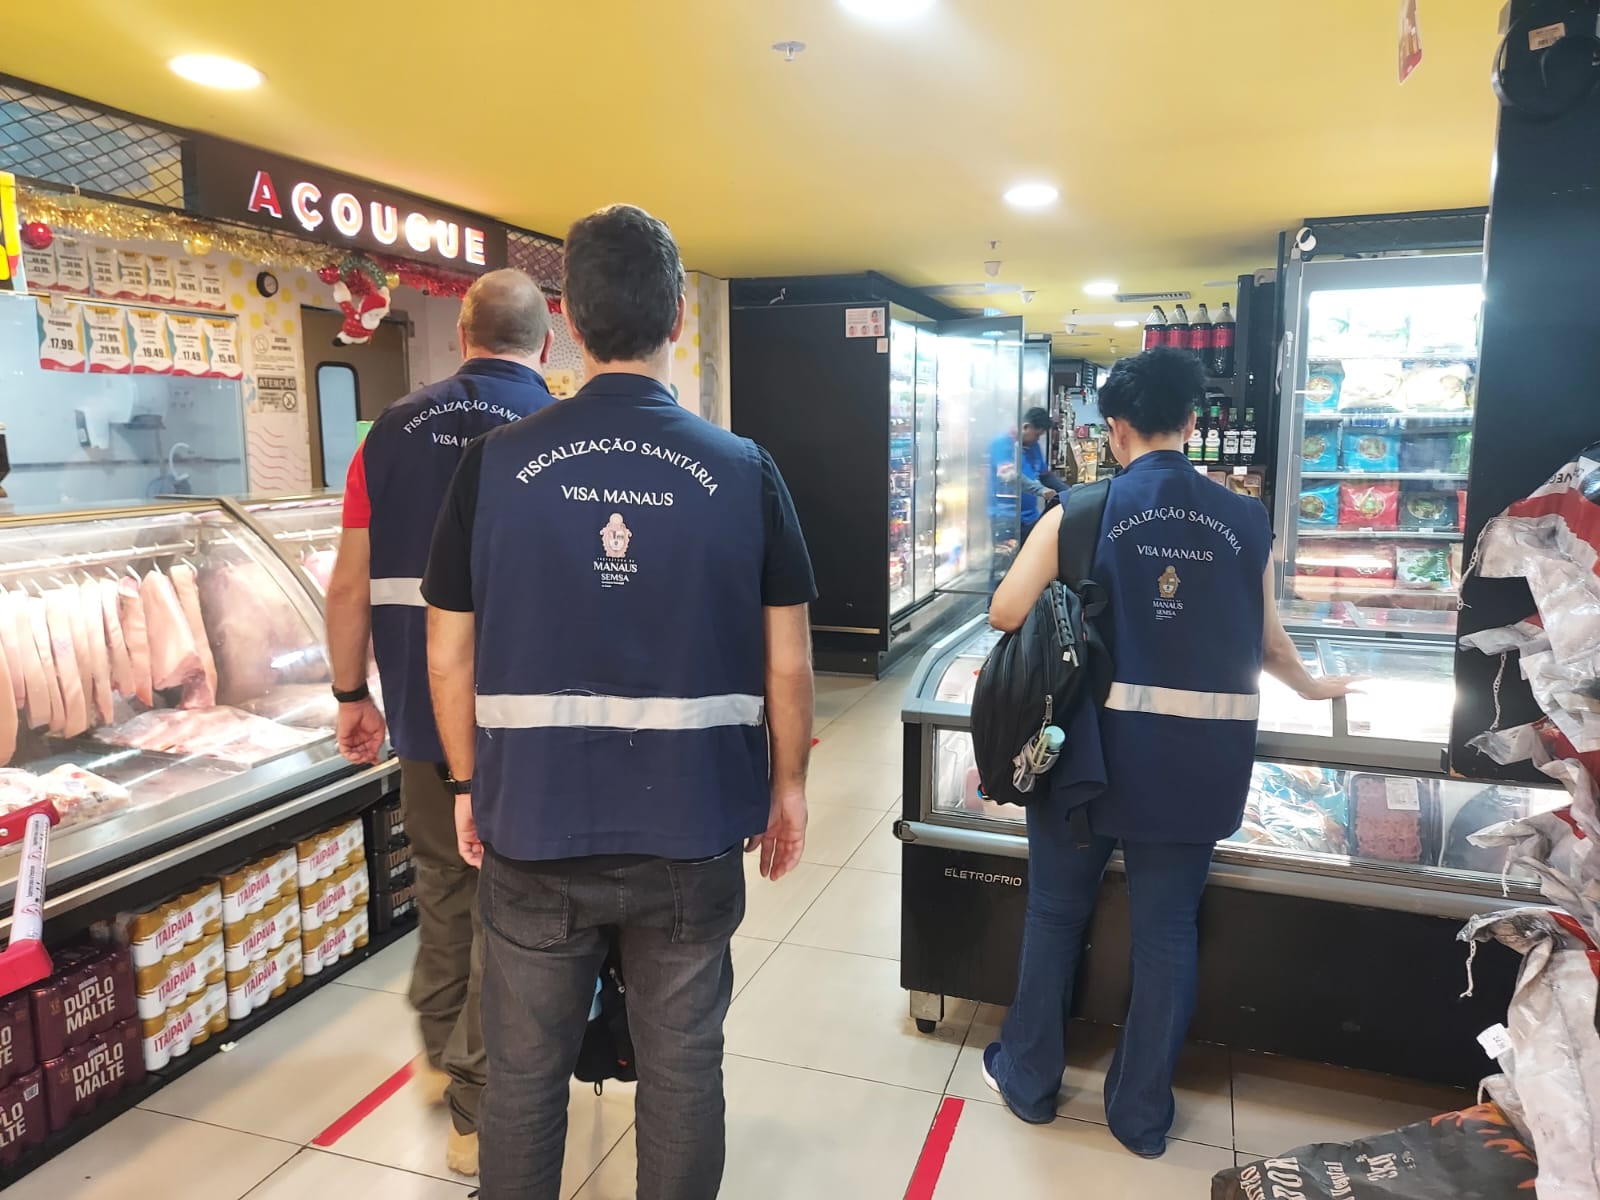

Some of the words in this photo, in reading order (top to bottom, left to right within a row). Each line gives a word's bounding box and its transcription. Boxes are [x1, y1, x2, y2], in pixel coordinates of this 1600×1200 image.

[248, 171, 486, 265] AÇOUGUE
[403, 399, 488, 434] FISCALIZAÇÃO
[432, 432, 458, 447] VISA
[515, 438, 637, 484] FISCALIZAÇÃO
[640, 442, 720, 497] SANITÁRIA
[561, 484, 600, 502] VISA
[603, 488, 674, 506] MANAUS
[1107, 507, 1185, 542] FISCALIZAÇÃO
[1188, 510, 1242, 556] SANITÁRIA
[593, 561, 638, 573] MANAUS
[1136, 544, 1159, 557] VISA
[1161, 547, 1214, 562] MANAUS
[601, 573, 630, 582] SEMSA
[1152, 601, 1183, 610] MANAUS
[309, 840, 340, 871] ITAIPAVA
[237, 872, 271, 907] ITAIPAVA
[944, 867, 1023, 887] ELETROFRIO
[316, 885, 346, 917] ITAIPAVA
[155, 911, 194, 950] ITAIPAVA
[242, 920, 277, 956] ITAIPAVA
[317, 928, 347, 961] ITAIPAVA
[158, 961, 197, 1002] ITAIPAVA
[243, 959, 278, 998] ITAIPAVA
[64, 976, 115, 1017] DUPLO
[66, 994, 116, 1035] MALTE
[154, 1012, 193, 1053] ITAIPAVA
[72, 1042, 124, 1084] DUPLO
[75, 1060, 125, 1102] MALTE
